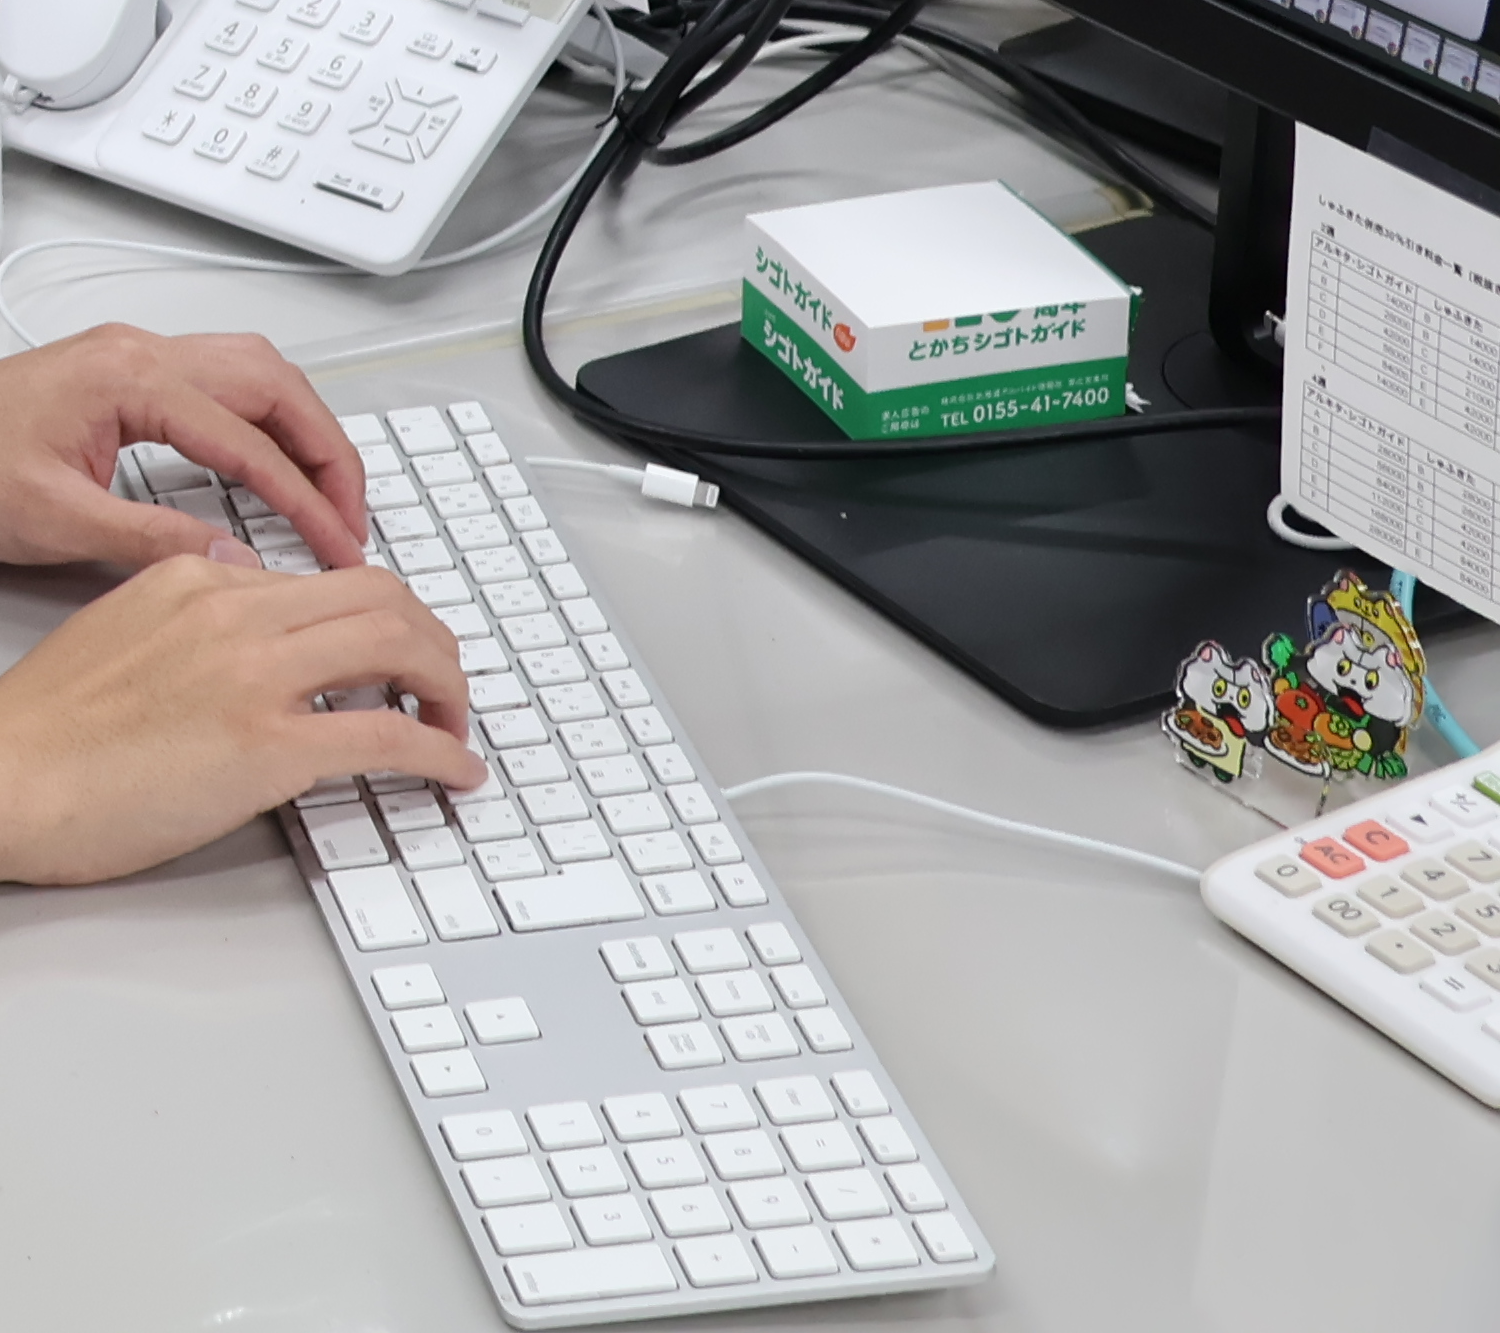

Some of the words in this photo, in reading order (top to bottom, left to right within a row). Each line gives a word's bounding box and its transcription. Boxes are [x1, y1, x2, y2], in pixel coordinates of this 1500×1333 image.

[359, 11, 376, 28] 3
[223, 21, 239, 37] 4
[277, 38, 293, 55] 5
[329, 55, 346, 71] 6
[194, 65, 210, 81] 7
[244, 83, 261, 99] 8
[299, 101, 313, 118] 9
[213, 128, 229, 144] 0
[756, 245, 833, 331] シゴトガイド
[908, 318, 1086, 362] とかちシゴトガイド
[763, 319, 844, 411] シゴトガイド
[941, 411, 969, 429] TEL
[973, 387, 1109, 424] 0155-41-7400
[1365, 829, 1390, 845] C
[1314, 844, 1350, 865] AC
[1468, 850, 1493, 864] 7
[1276, 864, 1298, 877] 0
[1422, 869, 1446, 881] 4
[1380, 886, 1399, 900] 1
[1476, 904, 1500, 919] 5
[1429, 921, 1457, 937] 2
